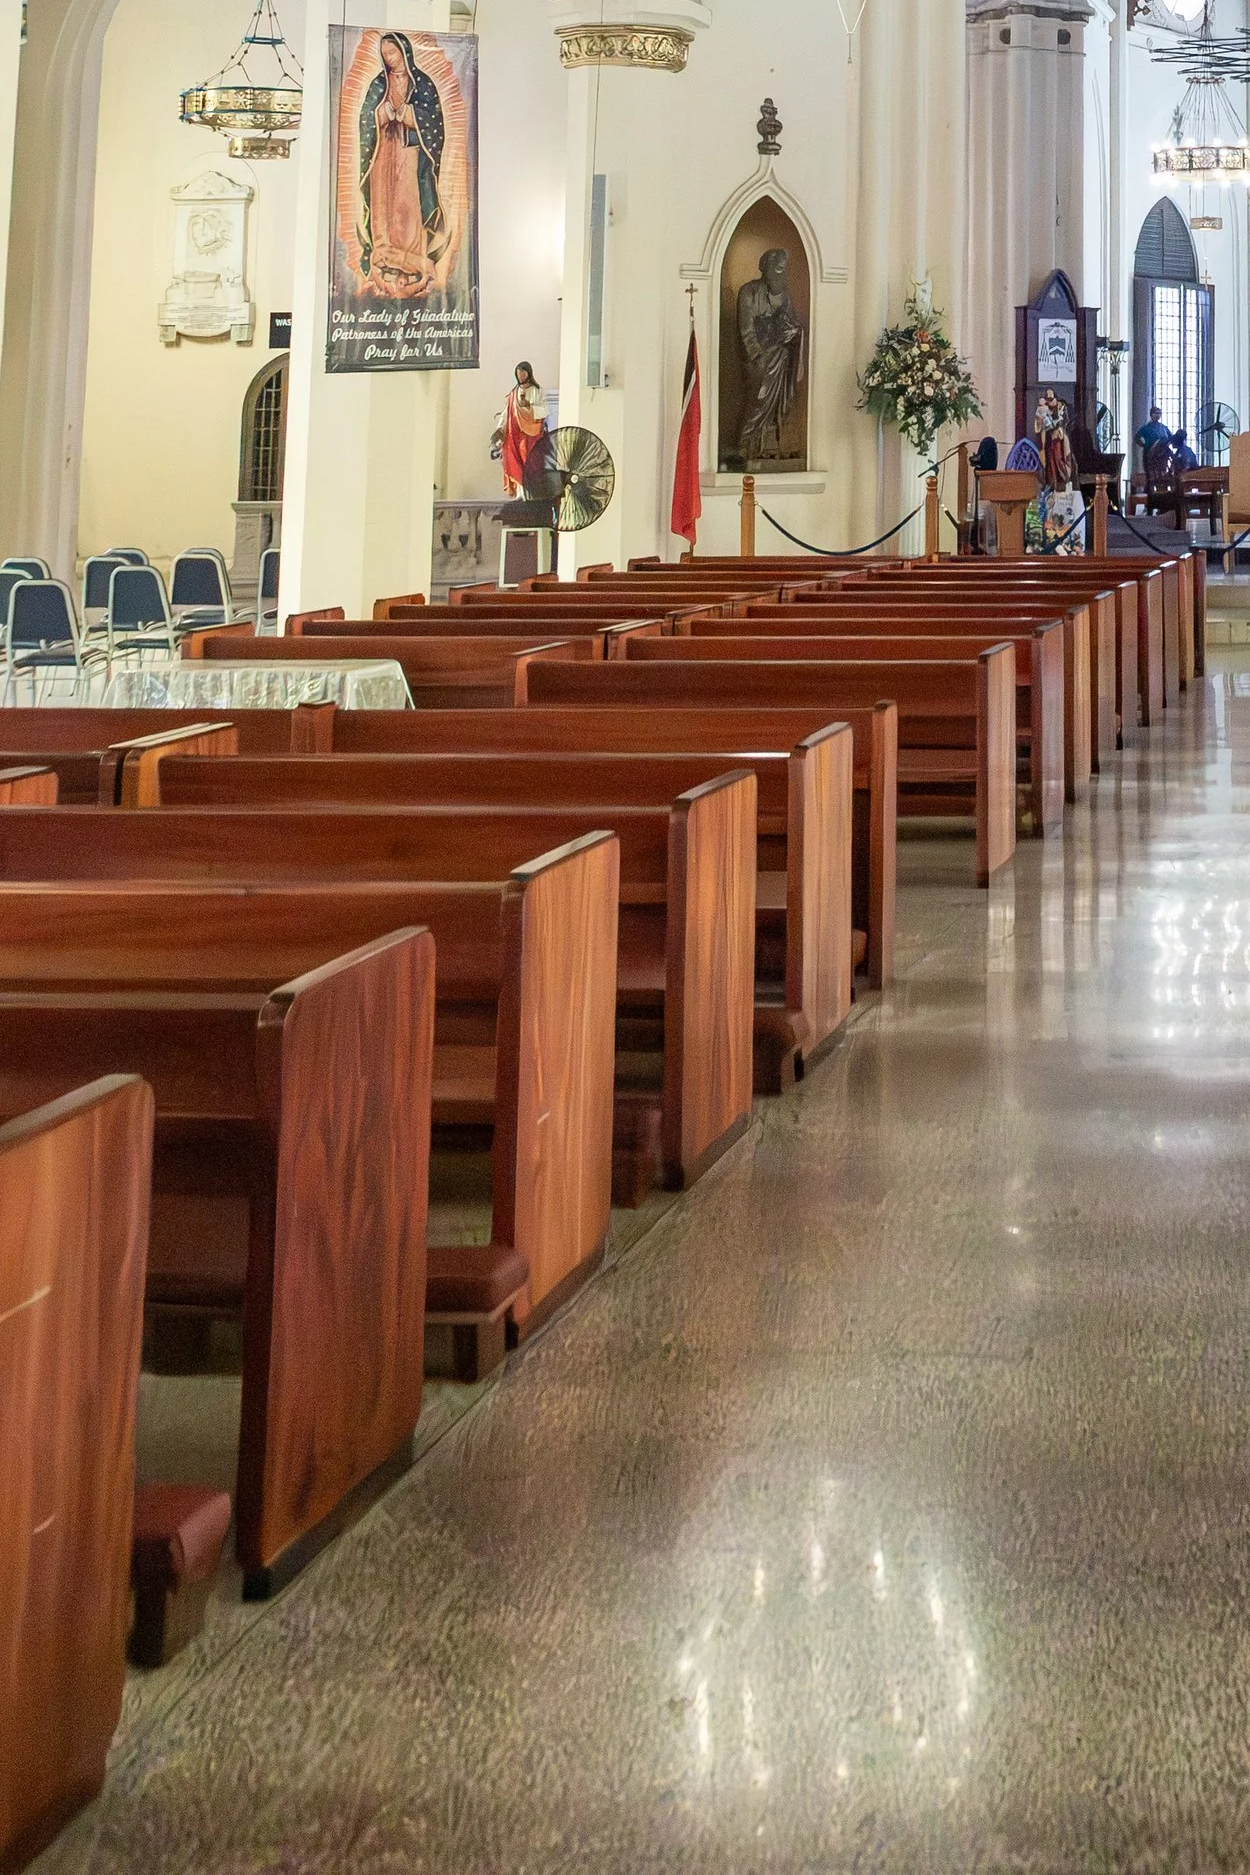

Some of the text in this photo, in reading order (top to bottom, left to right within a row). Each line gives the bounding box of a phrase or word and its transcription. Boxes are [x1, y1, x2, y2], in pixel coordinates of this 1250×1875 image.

[332, 309, 475, 326] Our Lady of Guadalupe
[331, 326, 473, 342] Patroness of the Americas
[364, 340, 443, 361] Pray for Us
